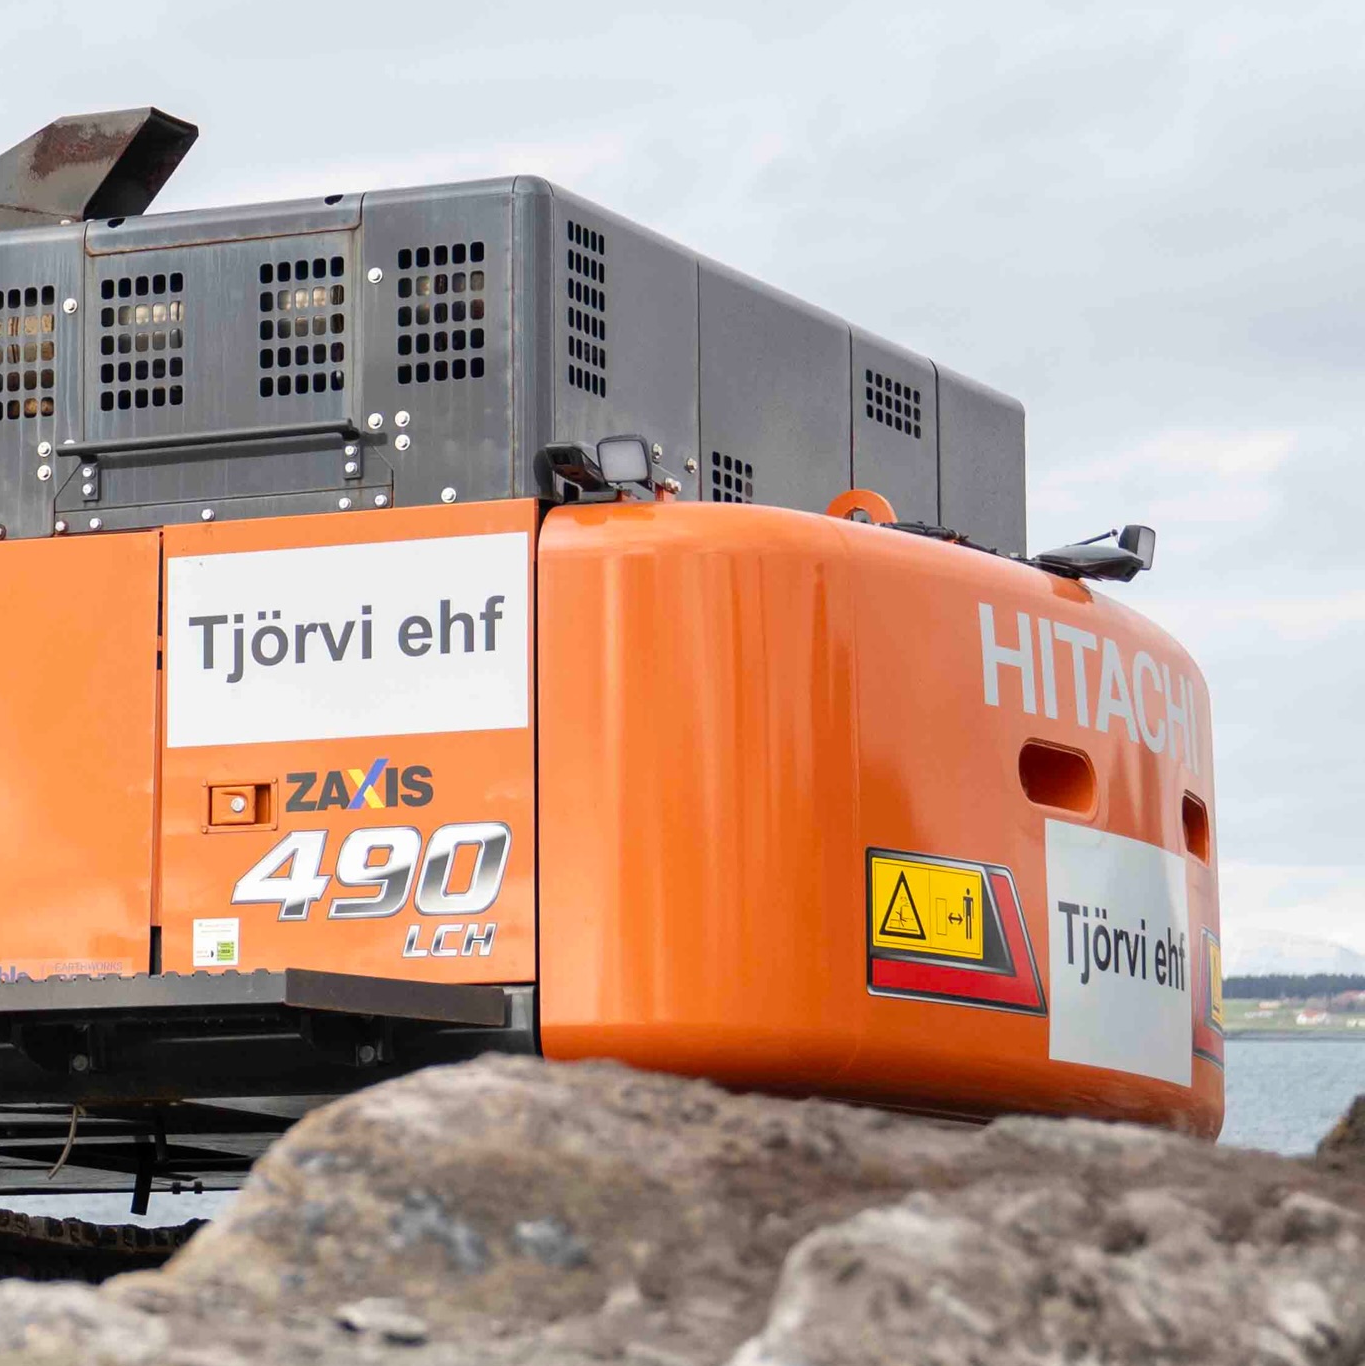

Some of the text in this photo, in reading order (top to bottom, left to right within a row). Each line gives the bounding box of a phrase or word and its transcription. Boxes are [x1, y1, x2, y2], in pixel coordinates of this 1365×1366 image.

[189, 595, 505, 683] Tjörvi ehf
[978, 601, 1199, 776] HITACHI
[285, 758, 434, 812] ZAXIS
[230, 821, 512, 921] 490
[402, 922, 498, 958] LCH
[1058, 901, 1185, 991] Tjörvi ehf
